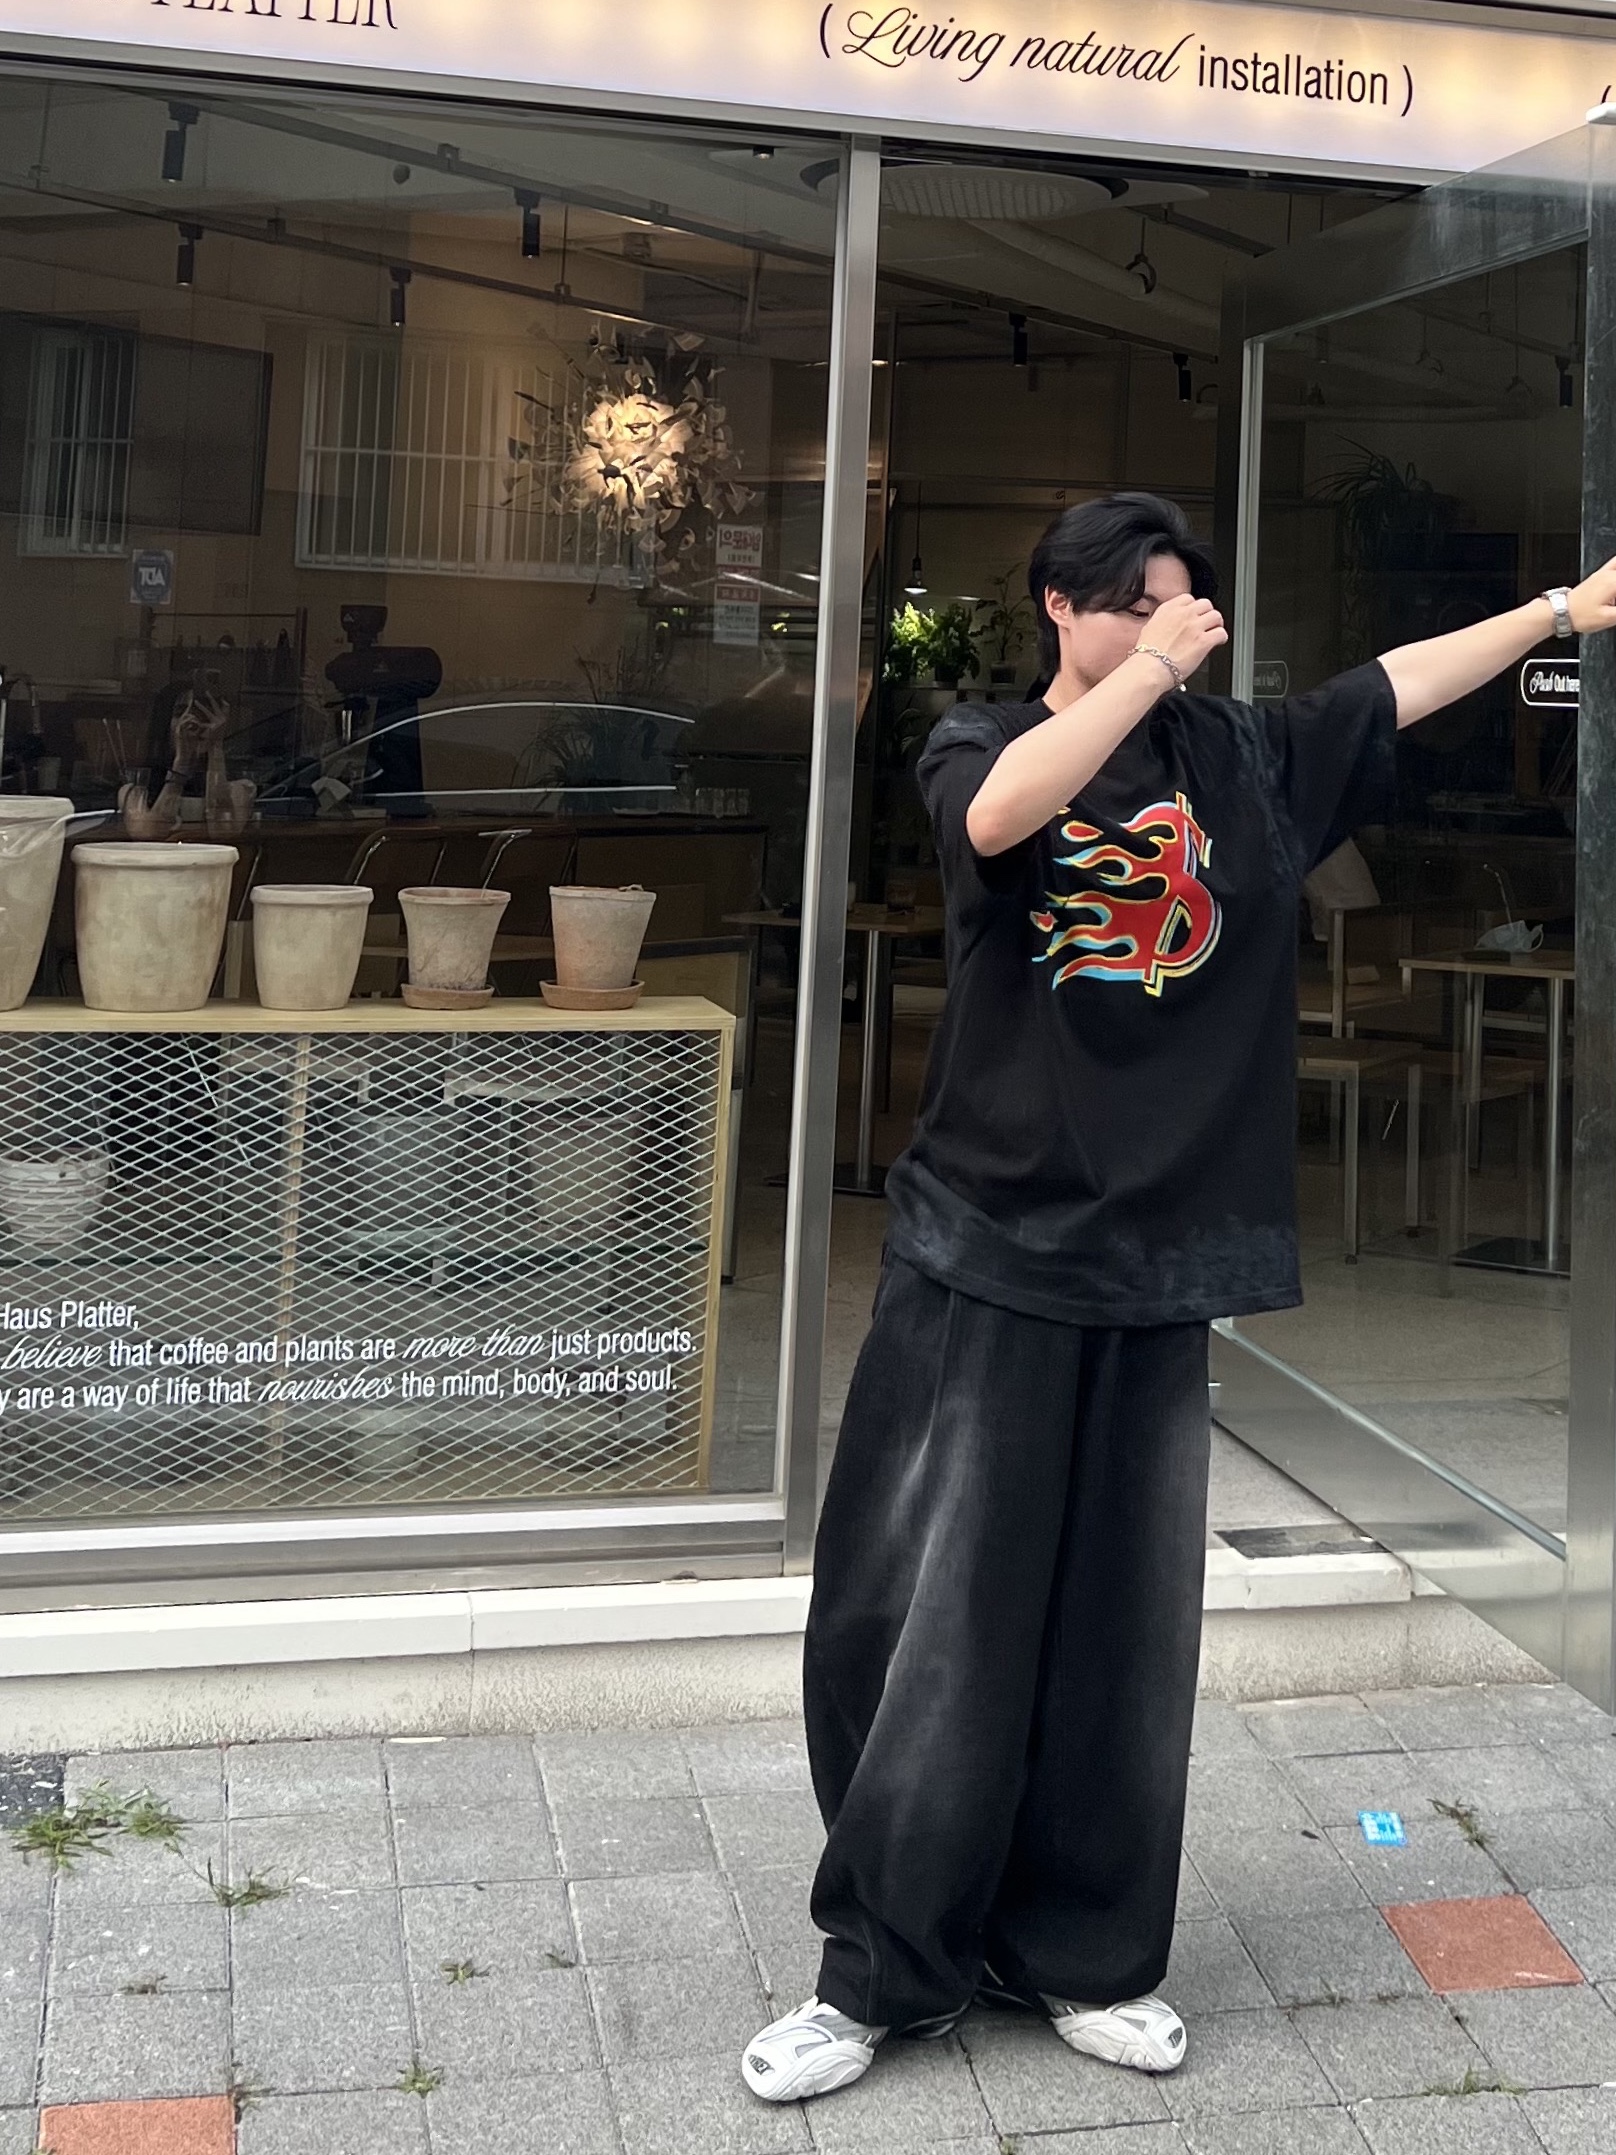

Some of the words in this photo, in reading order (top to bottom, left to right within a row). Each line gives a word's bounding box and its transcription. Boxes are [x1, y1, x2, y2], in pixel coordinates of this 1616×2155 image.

[1009, 32, 1196, 85] natural
[60, 1300, 139, 1331] Platter,
[1, 1334, 102, 1370] believe
[109, 1338, 152, 1367] that
[160, 1337, 229, 1365] coffee
[235, 1335, 278, 1364] and
[285, 1332, 354, 1367] plants
[360, 1338, 396, 1361] are
[402, 1335, 478, 1359] more
[481, 1324, 545, 1356] than
[549, 1329, 591, 1361] just
[597, 1326, 697, 1360] products.
[17, 1386, 54, 1410] are
[61, 1386, 75, 1409] a
[83, 1384, 129, 1412] way
[135, 1377, 159, 1405] of
[166, 1377, 201, 1404] life
[208, 1376, 252, 1403] that
[257, 1366, 395, 1401] nourishes
[401, 1371, 435, 1397] the
[442, 1369, 504, 1399] mind,
[513, 1367, 571, 1399] body,
[578, 1365, 619, 1393] and
[625, 1364, 678, 1392] soul.
